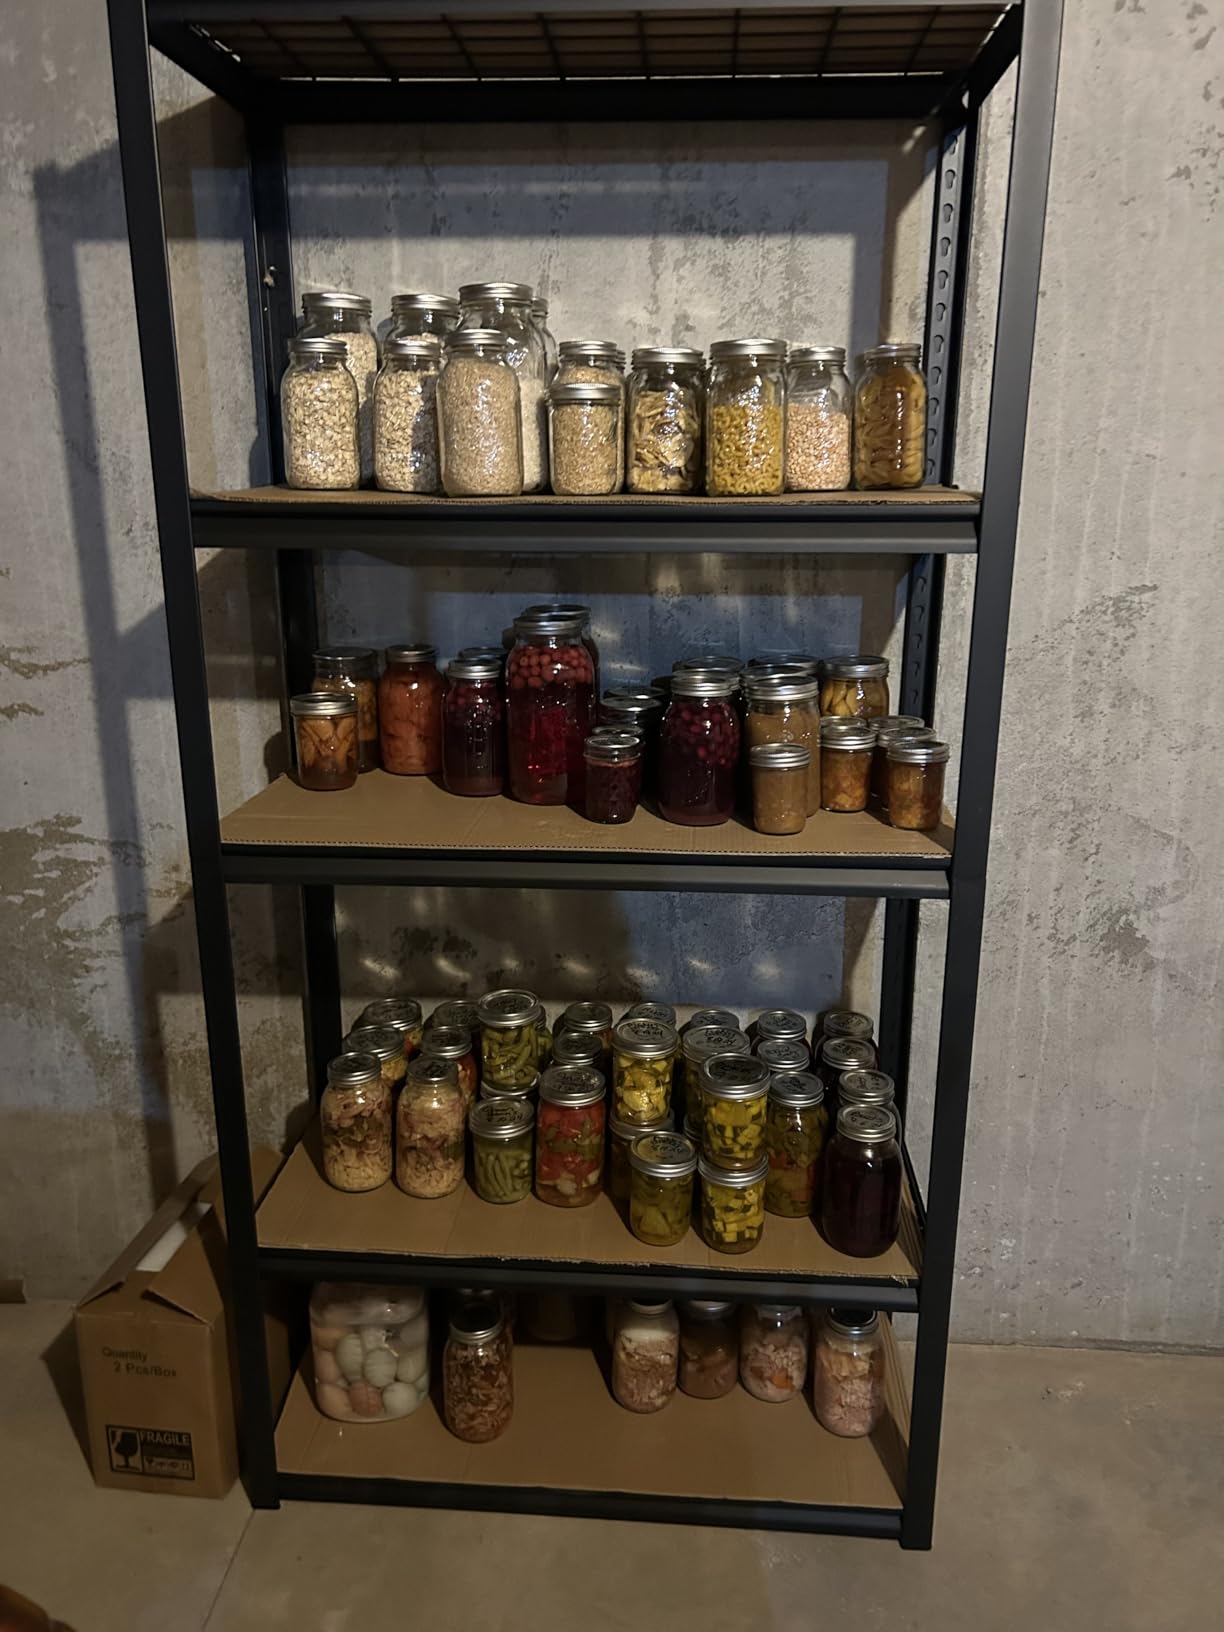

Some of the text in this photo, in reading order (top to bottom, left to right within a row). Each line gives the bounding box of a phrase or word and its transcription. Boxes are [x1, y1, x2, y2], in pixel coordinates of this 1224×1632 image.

[102, 1347, 148, 1363] Quantity
[113, 1360, 121, 1373] 2
[139, 1431, 190, 1447] FRAGILE
